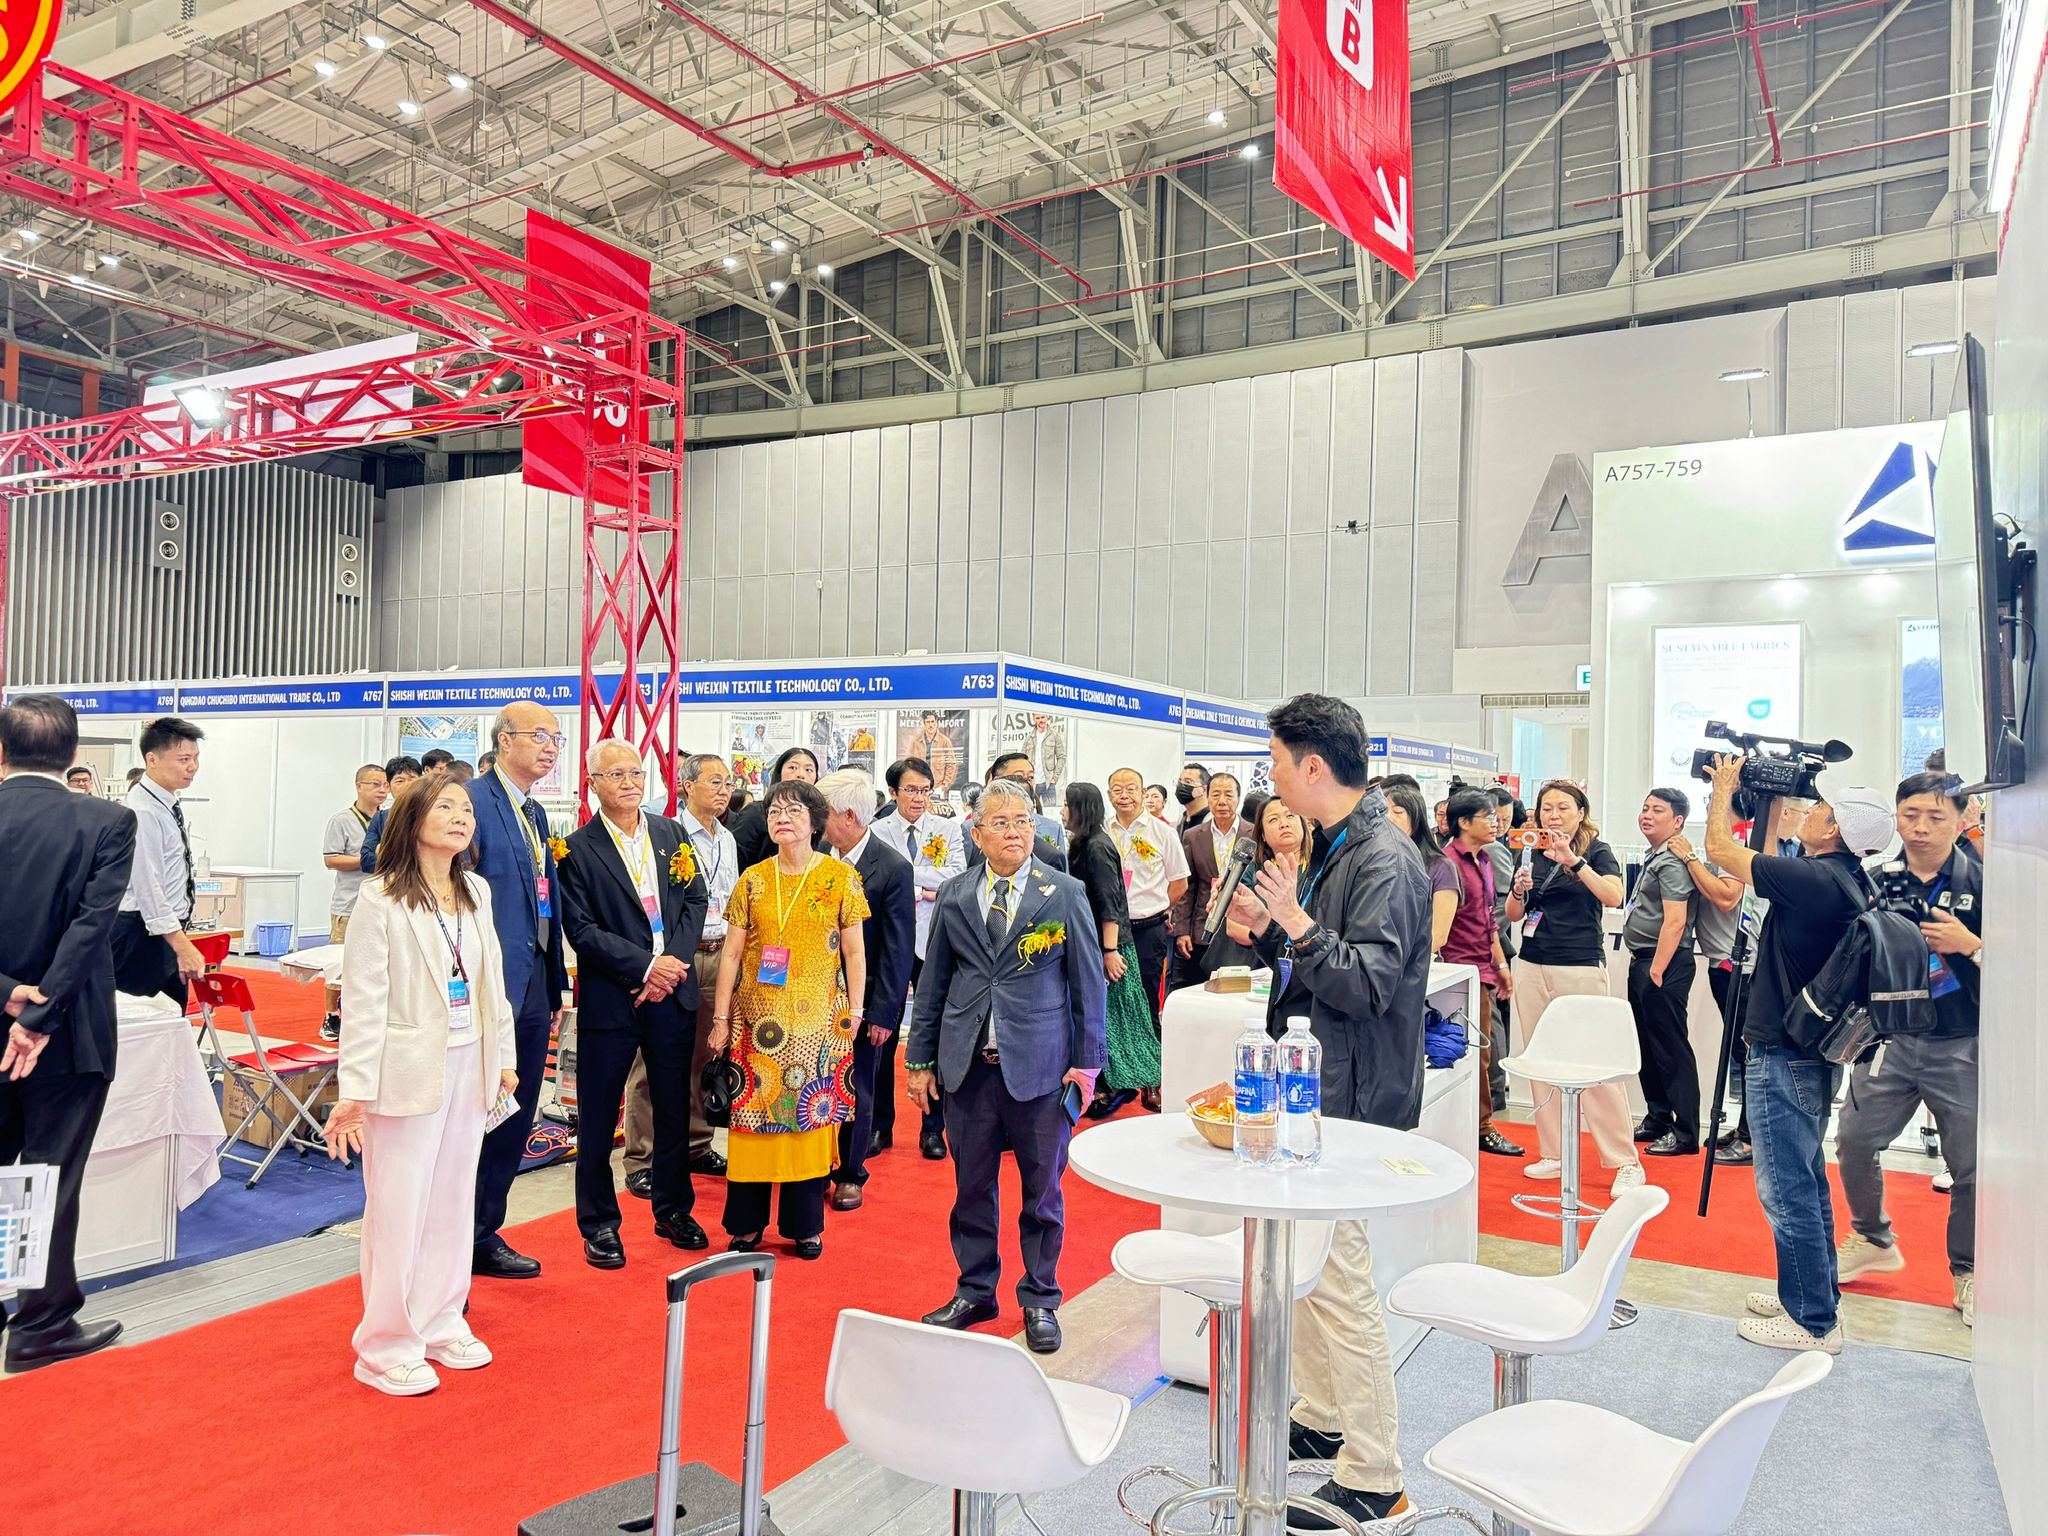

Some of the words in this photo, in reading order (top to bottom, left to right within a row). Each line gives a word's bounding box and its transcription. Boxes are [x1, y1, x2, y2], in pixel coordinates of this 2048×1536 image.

[1341, 7, 1361, 65] B
[1605, 459, 1702, 483] A757-759
[1500, 452, 1593, 588] A
[695, 681, 729, 695] WEIXIN
[731, 680, 772, 694] TEXTILE
[776, 679, 841, 693] TECHNOLOGY
[844, 678, 865, 694] CO.,
[869, 677, 893, 691] LTD.
[962, 674, 995, 689] A763
[157, 695, 173, 706] A769
[180, 695, 206, 707] QINGDAO
[239, 693, 287, 704] INTERNATIONAL
[288, 692, 311, 703] TRADE
[312, 692, 325, 704] CO.,
[327, 691, 340, 702] LTD
[362, 690, 383, 701] A767
[390, 689, 415, 701] SHISHI
[416, 689, 444, 701] WEIXIN
[445, 688, 477, 700] TEXTILE
[479, 687, 532, 699] TECHNOLOGY
[533, 686, 551, 700] CO.,
[552, 686, 572, 698] LTD.
[1005, 675, 1029, 693] SHISHI
[1030, 679, 1053, 697] WEIXIN
[1054, 684, 1079, 700] TEXTILE
[1080, 688, 1117, 706] TECHNOLOGY
[1117, 696, 1128, 710] CO.,
[1128, 698, 1141, 711] LTD.
[86, 699, 98, 708] LTD.
[1168, 705, 1182, 718] A763
[1219, 713, 1234, 725] TEXTILE
[899, 719, 924, 728] MEETS
[939, 718, 965, 729] MFORT
[763, 960, 778, 969] VIP
